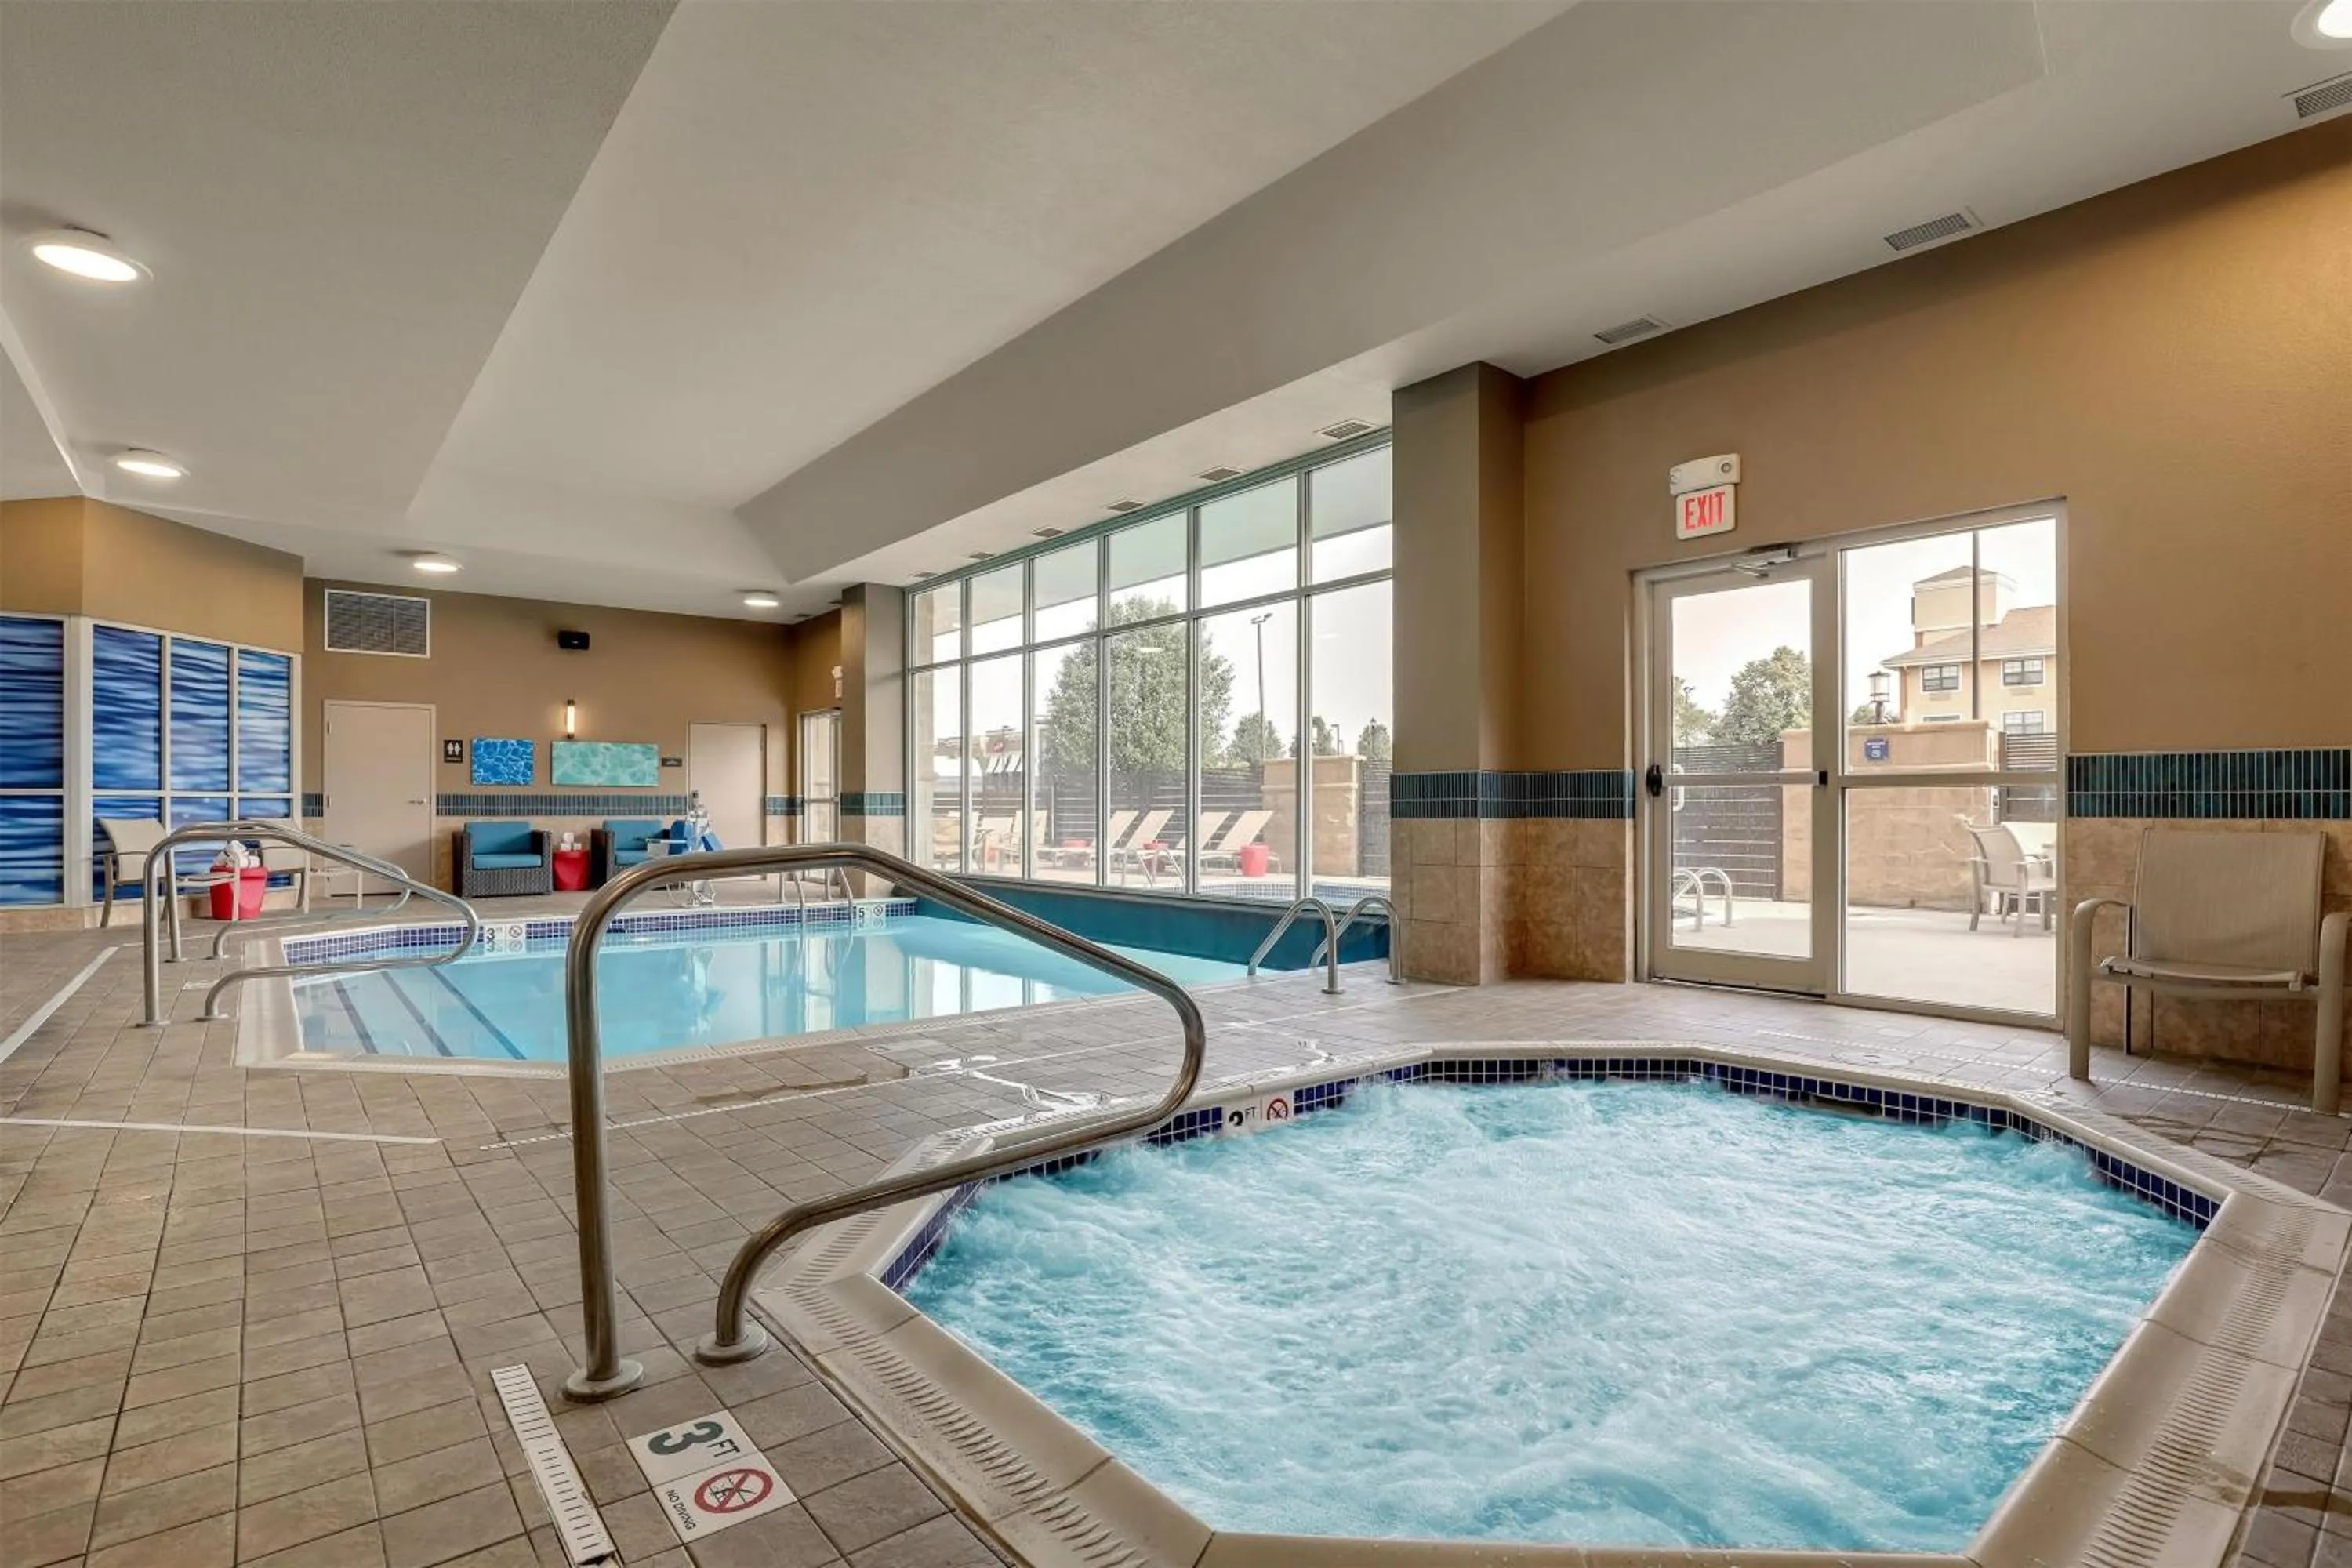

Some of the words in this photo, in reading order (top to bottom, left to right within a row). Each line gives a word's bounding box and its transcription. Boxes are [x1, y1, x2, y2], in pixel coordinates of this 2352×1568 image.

[1685, 492, 1726, 529] EXIT
[858, 907, 865, 918] 5
[487, 927, 495, 940] 3
[1245, 1106, 1256, 1119] FT
[648, 1421, 723, 1455] 3
[707, 1439, 740, 1457] FT
[666, 1490, 679, 1502] NO
[673, 1503, 696, 1530] DIVING
